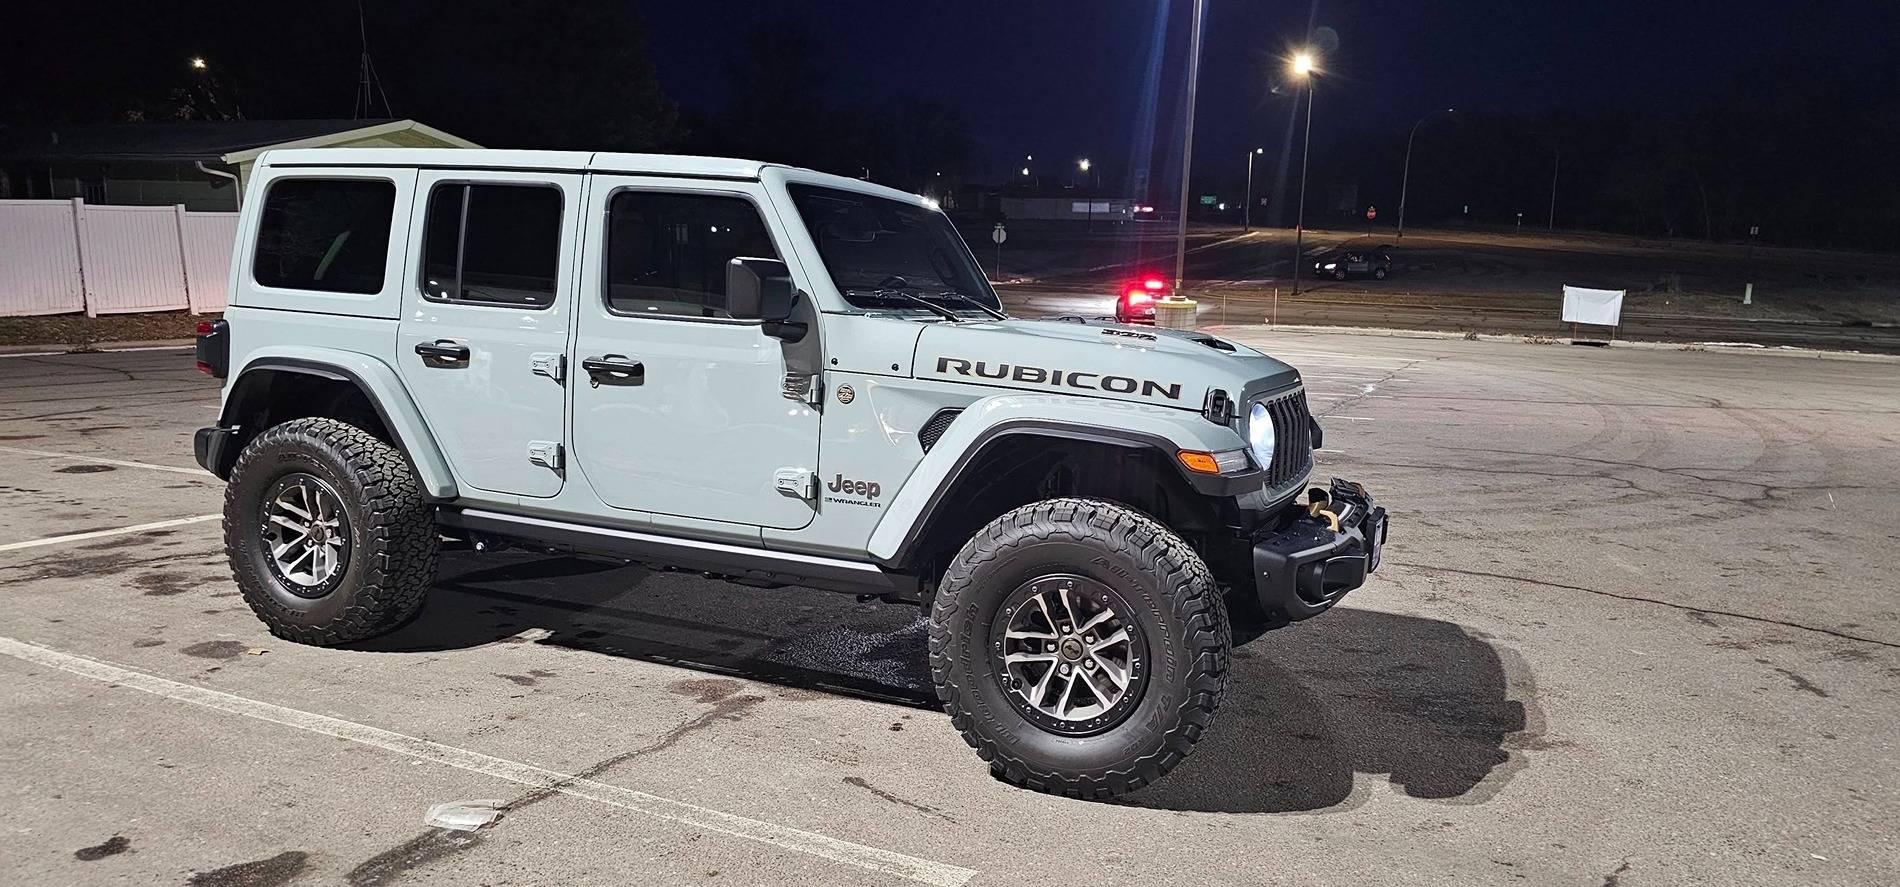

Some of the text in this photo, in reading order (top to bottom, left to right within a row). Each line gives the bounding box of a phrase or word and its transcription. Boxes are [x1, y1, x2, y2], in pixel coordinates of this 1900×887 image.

[936, 357, 1182, 400] RUBICON
[828, 474, 881, 500] Jeep
[833, 498, 881, 508] WRANGLER
